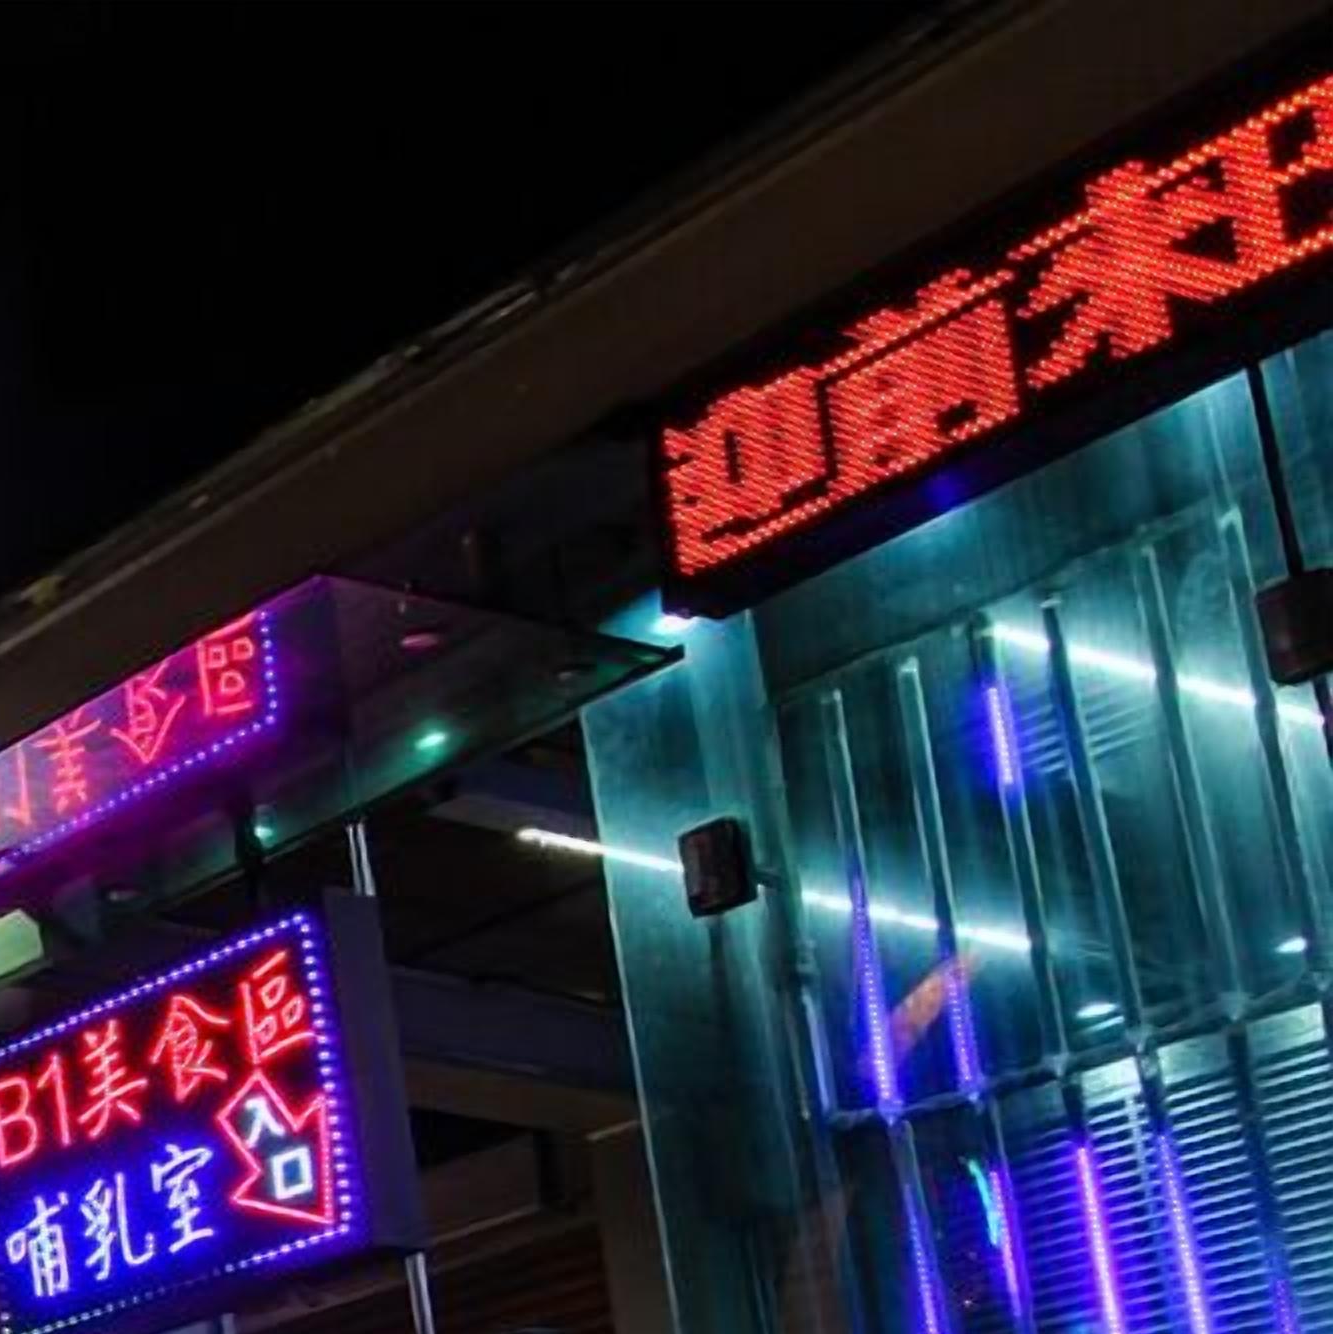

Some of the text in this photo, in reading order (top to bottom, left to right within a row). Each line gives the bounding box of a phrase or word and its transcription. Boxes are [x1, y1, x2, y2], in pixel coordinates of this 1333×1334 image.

[244, 1095, 314, 1200] 入口
[6, 1142, 215, 1298] 哺乳室
